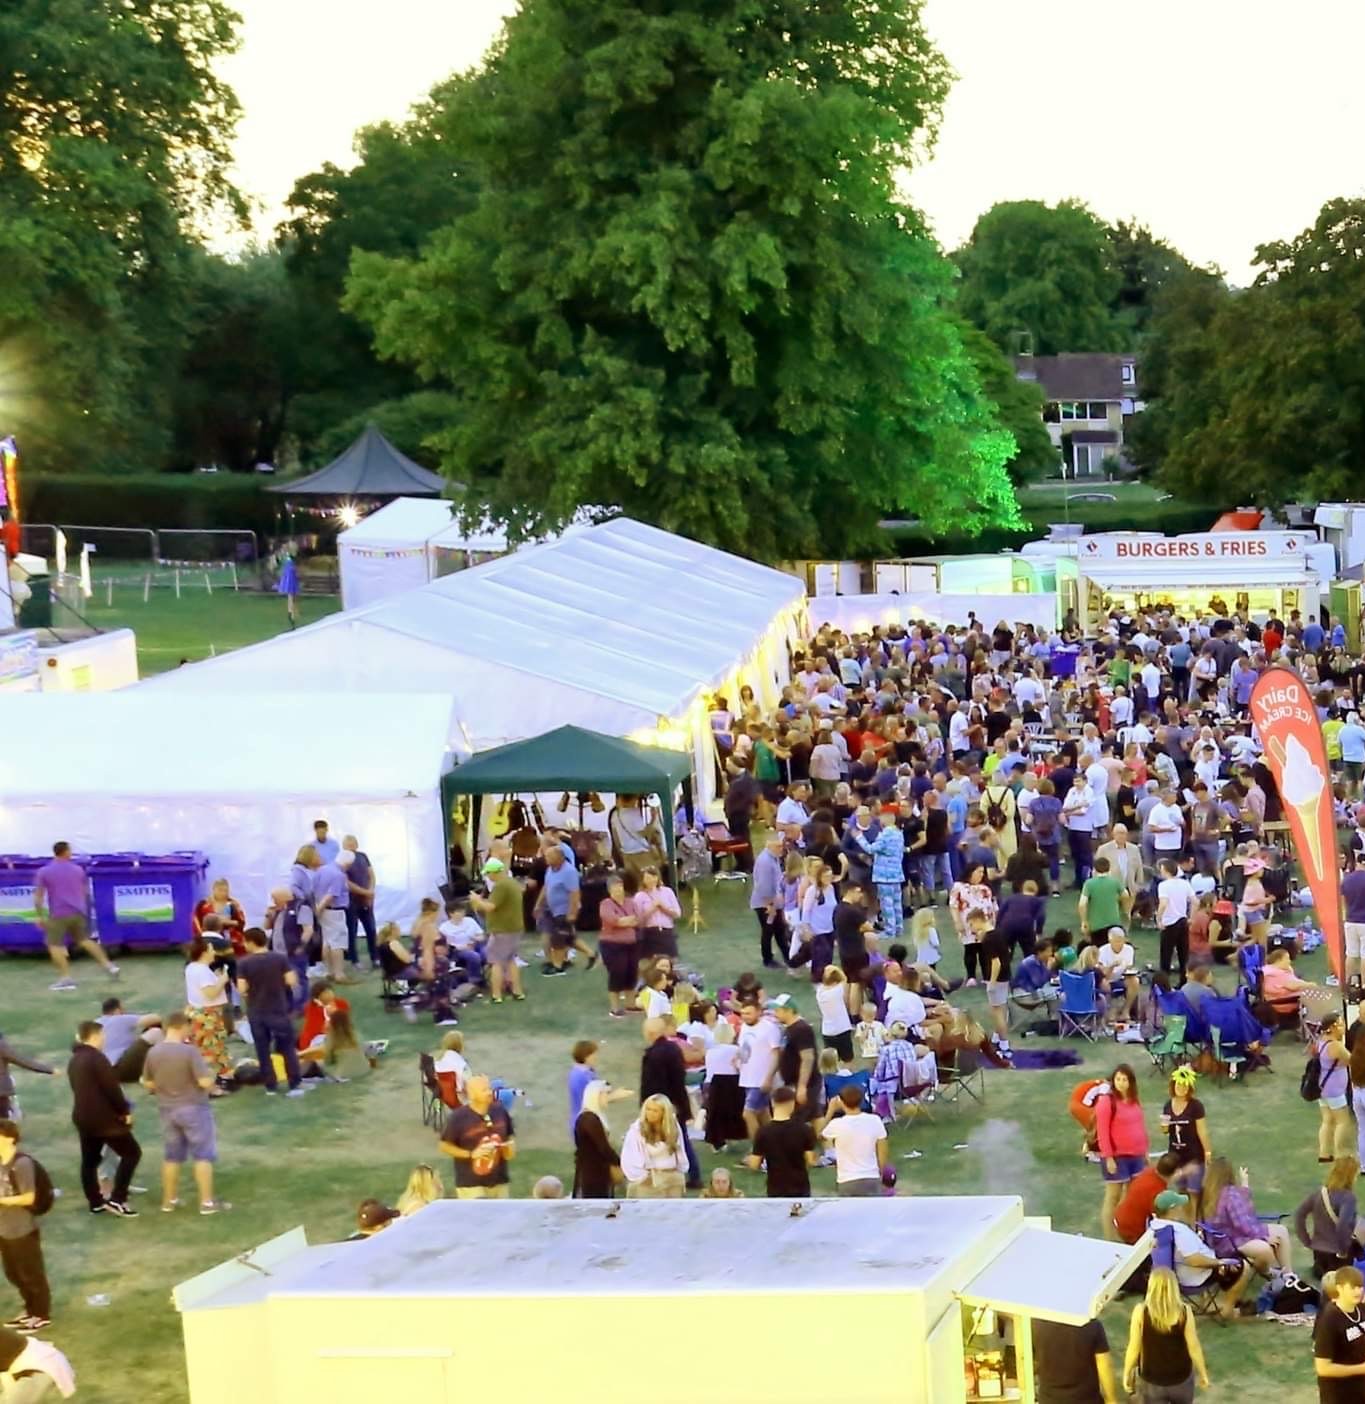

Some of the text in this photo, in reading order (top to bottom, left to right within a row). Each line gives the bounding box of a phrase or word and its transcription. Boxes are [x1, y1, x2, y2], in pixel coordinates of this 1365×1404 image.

[1116, 541, 1266, 557] BURGERS & FRIES
[117, 886, 170, 897] SMITHS
